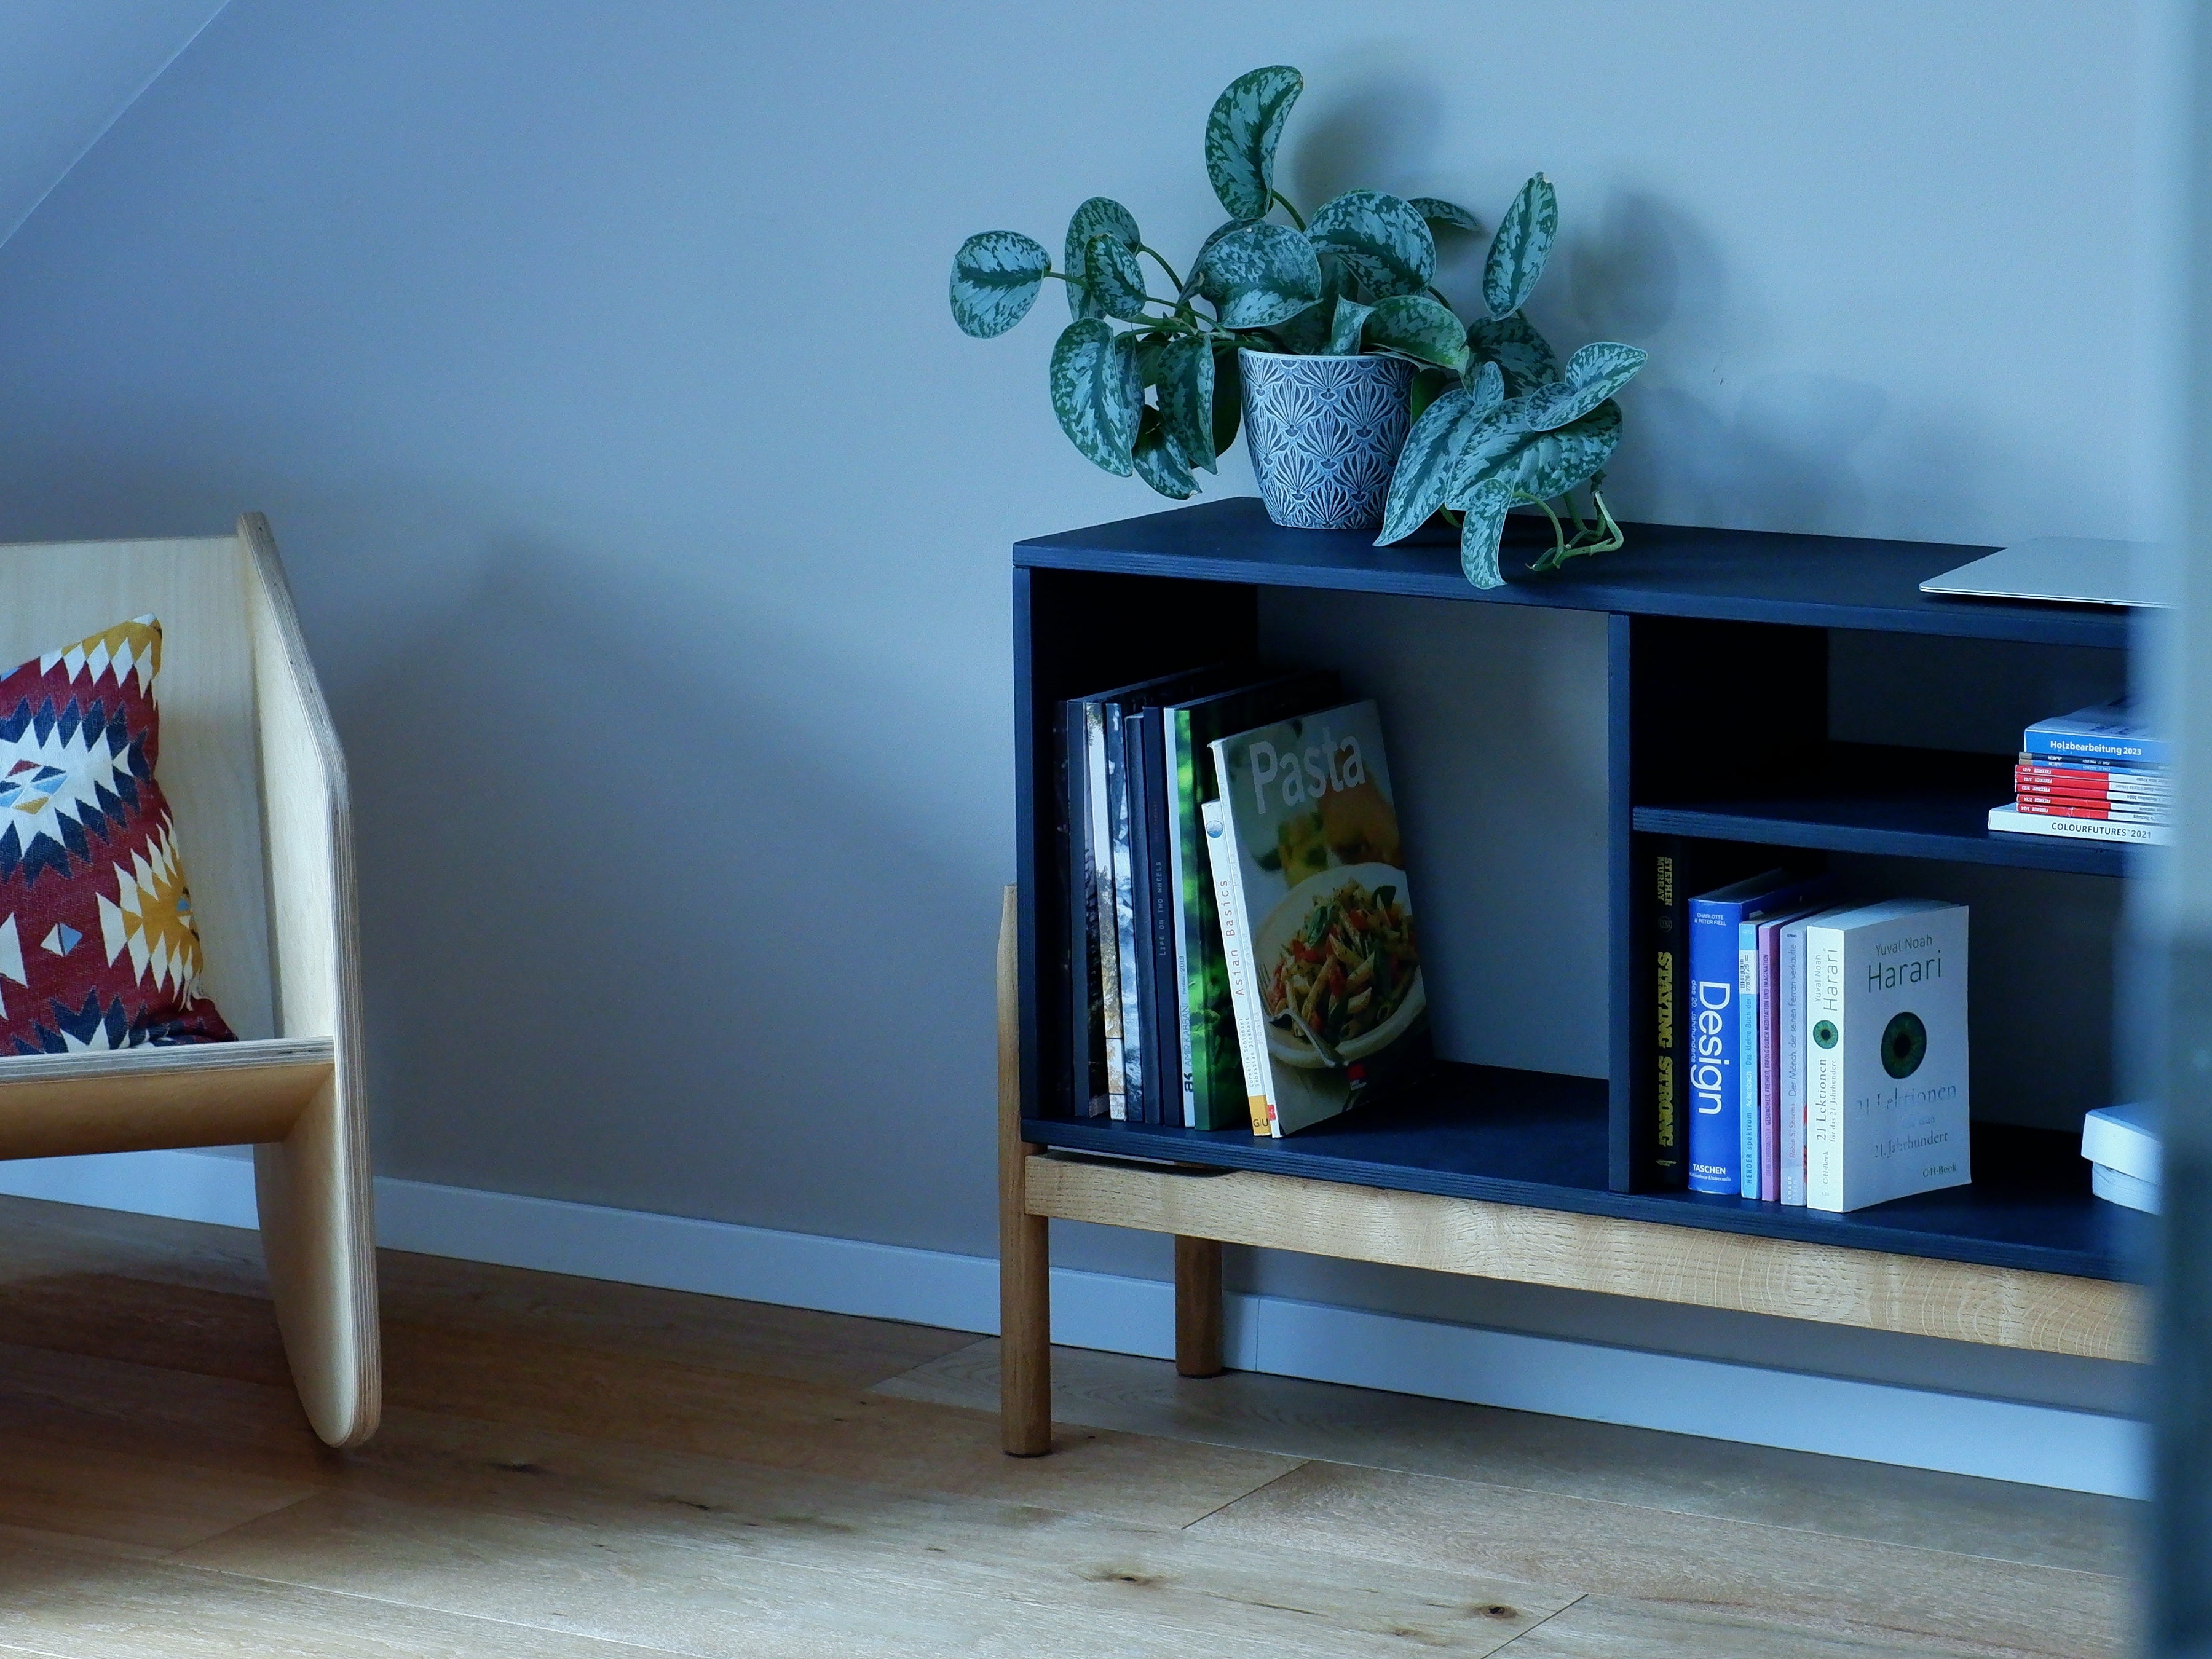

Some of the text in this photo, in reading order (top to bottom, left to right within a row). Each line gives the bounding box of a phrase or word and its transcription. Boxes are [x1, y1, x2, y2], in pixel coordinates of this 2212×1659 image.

[2050, 741, 2142, 755] Holzbearbeitung 2023
[1249, 727, 1365, 814] Pasta
[2131, 830, 2151, 838] 2021
[1159, 920, 1165, 930] ON
[1220, 880, 1245, 996] Asian Basics
[1875, 934, 1932, 956] Yuval Noah
[1787, 944, 1797, 980] verkaufte
[1823, 948, 1838, 1011] Harari
[1869, 949, 1941, 993] Harari
[1244, 1017, 1260, 1087] Sebastian Dickhaut
[1657, 952, 1673, 1147] STAYING STRONG
[1691, 981, 1731, 1114] Design
[1788, 1035, 1797, 1049] der
[1245, 1056, 1254, 1088] Cornelia
[1788, 1081, 1797, 1097] Der
[1829, 1060, 1838, 1105] Jahrhundert
[1815, 1058, 1827, 1141] 21 Lektionen
[1693, 1163, 1726, 1175] TASCHEN
